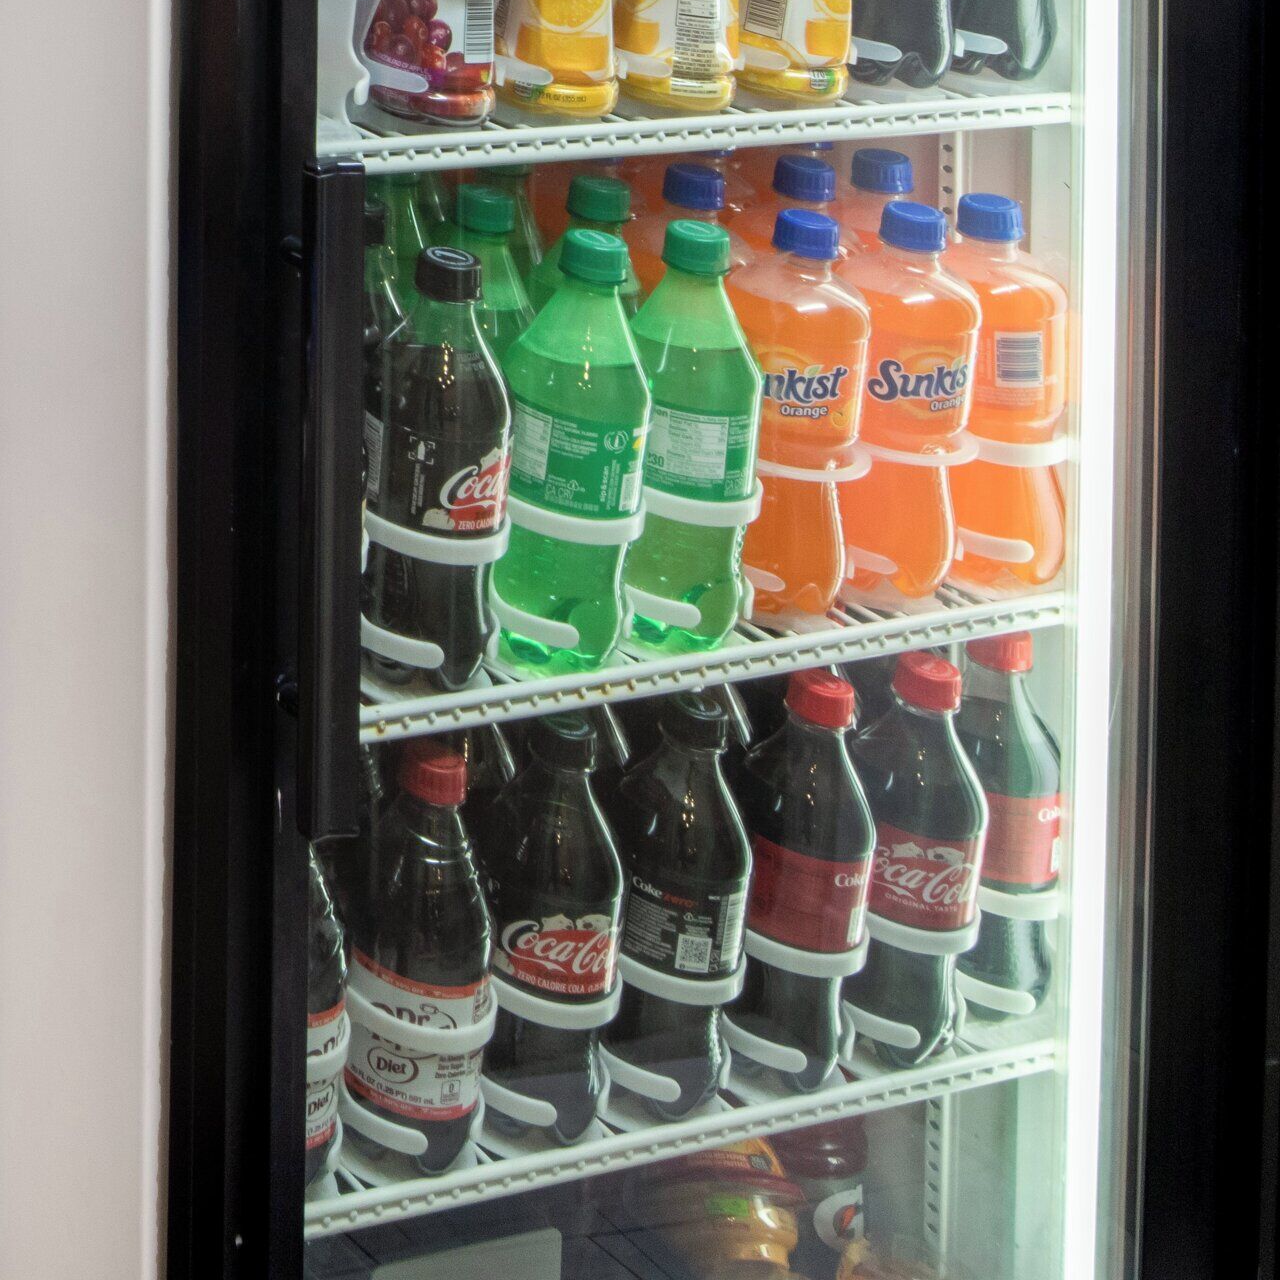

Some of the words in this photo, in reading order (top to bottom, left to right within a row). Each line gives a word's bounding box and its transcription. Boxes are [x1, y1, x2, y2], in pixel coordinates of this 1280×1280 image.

[780, 403, 830, 419] Orange
[632, 876, 663, 899] Coke
[885, 892, 932, 913] ORIGINAL
[517, 970, 537, 986] ZERO
[537, 978, 567, 993] CALORIE
[568, 983, 586, 994] COLA
[376, 1056, 408, 1075] Diet
